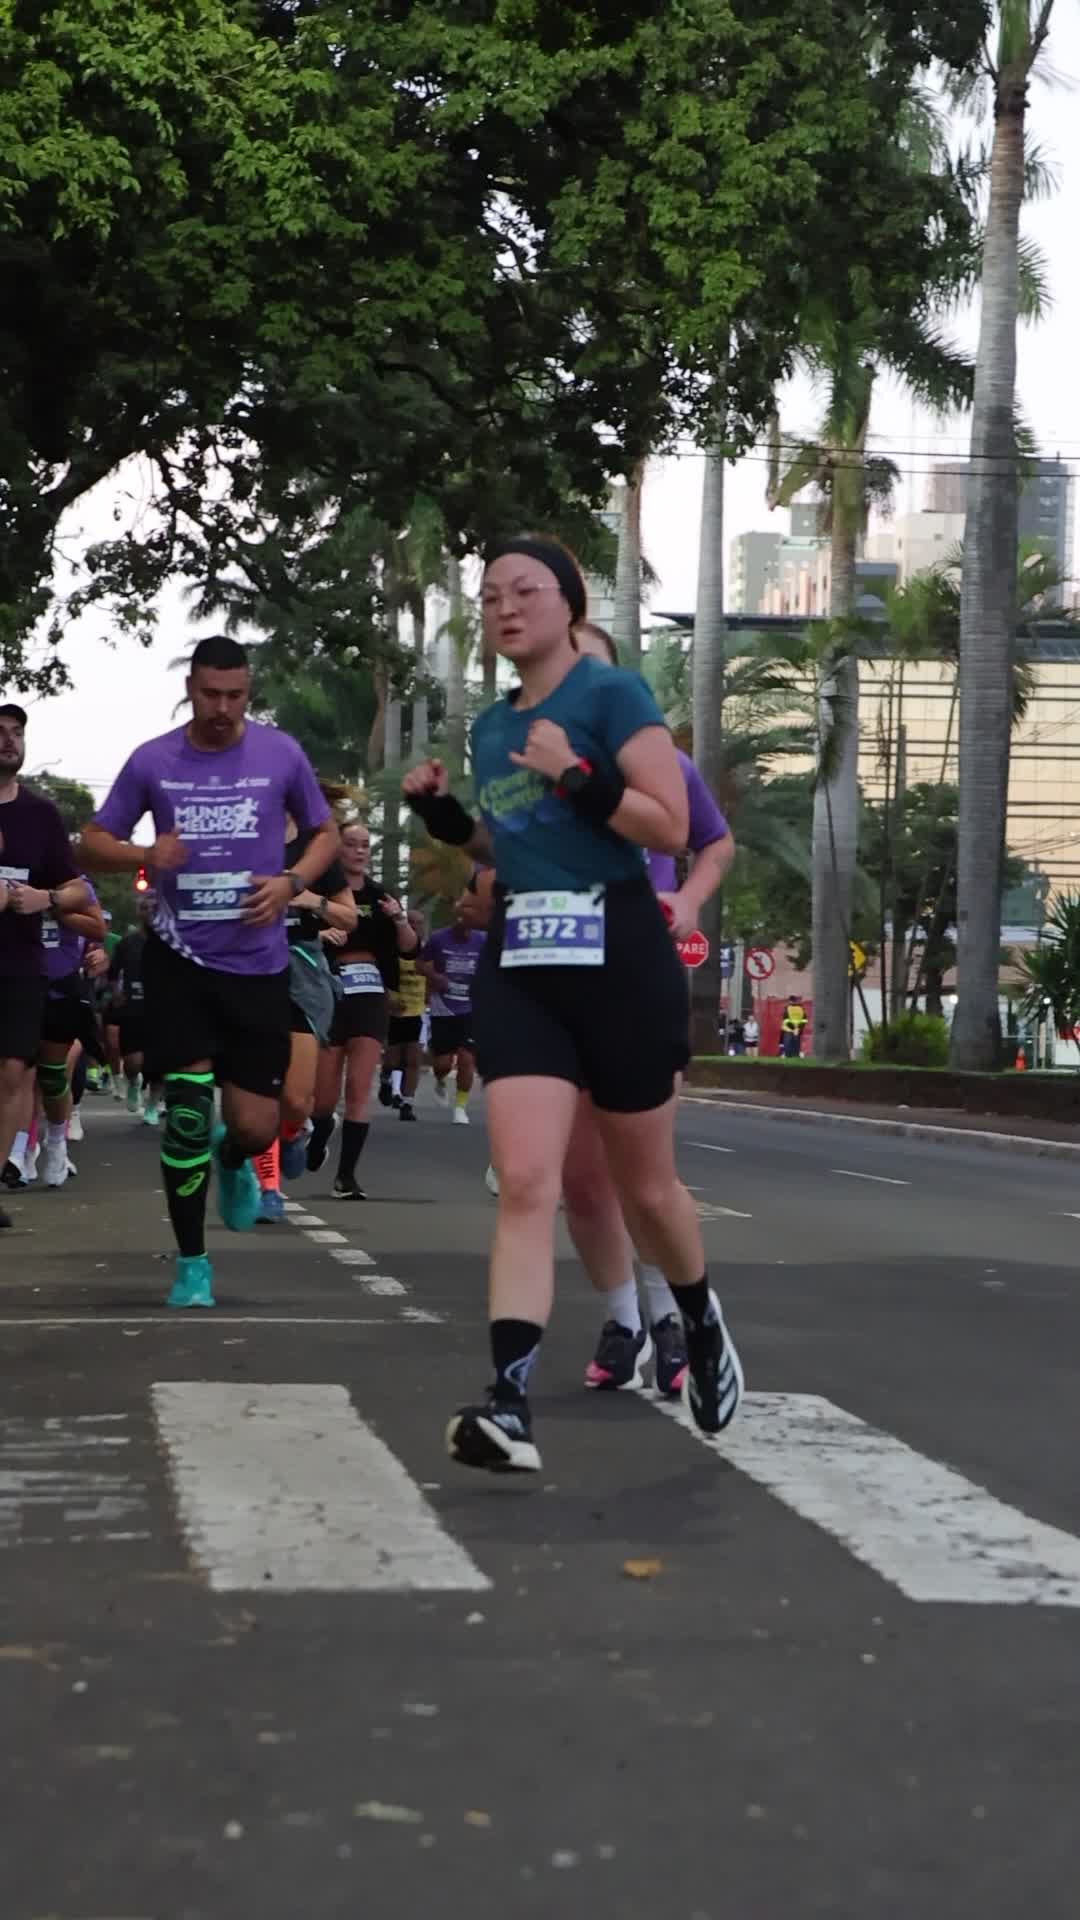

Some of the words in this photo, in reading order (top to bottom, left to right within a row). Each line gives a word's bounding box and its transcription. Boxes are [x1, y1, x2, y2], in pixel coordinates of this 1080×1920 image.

[192, 890, 237, 905] 5690
[517, 917, 577, 940] 5372
[676, 943, 705, 954] PARE
